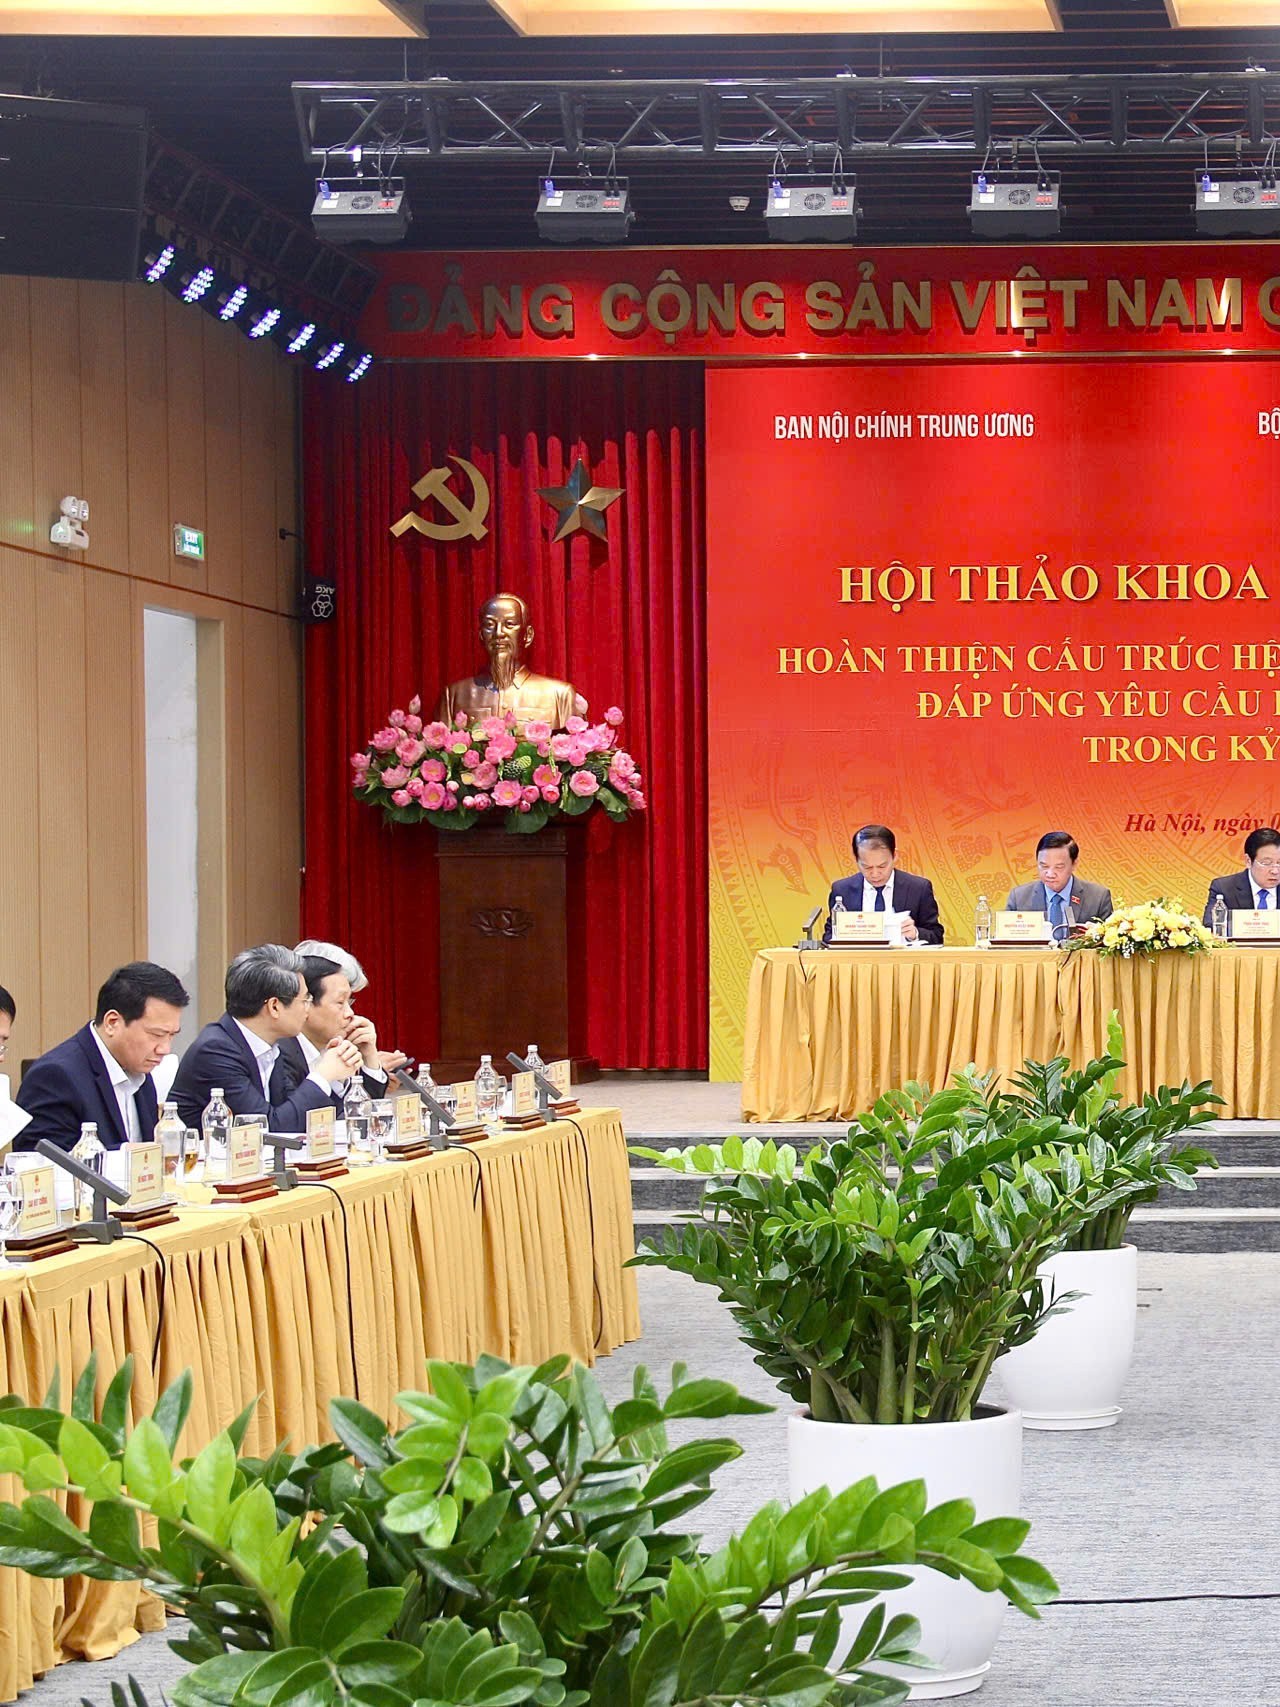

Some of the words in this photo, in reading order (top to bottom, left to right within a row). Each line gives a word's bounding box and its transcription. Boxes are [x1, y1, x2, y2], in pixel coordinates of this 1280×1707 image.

[387, 262, 576, 336] ĐẢNG
[601, 269, 786, 344] CỘNG
[805, 261, 932, 332] SẢN
[950, 265, 1088, 340] VIỆT
[1107, 277, 1242, 328] NAM
[774, 415, 813, 439] BAN
[818, 410, 849, 444] NỘI
[854, 410, 912, 439] CHÍNH
[916, 414, 979, 438] TRUNG
[984, 411, 1034, 438] ƯƠNG
[838, 560, 936, 612] HỘI
[949, 554, 1099, 601] THẢO
[1115, 563, 1270, 600] KHOA
[777, 638, 886, 674] HOÀN
[897, 641, 1015, 680] THIỆN
[1027, 637, 1106, 672] CẤU
[1116, 636, 1220, 671] TRÚC
[916, 683, 992, 718] ĐÁP
[1002, 682, 1086, 718] ỨNG
[1094, 681, 1171, 717] YÊU
[1182, 680, 1262, 717] CẦU
[1082, 734, 1217, 763] TRONG
[1124, 813, 1156, 832] Hà
[1163, 813, 1206, 837] Nội,
